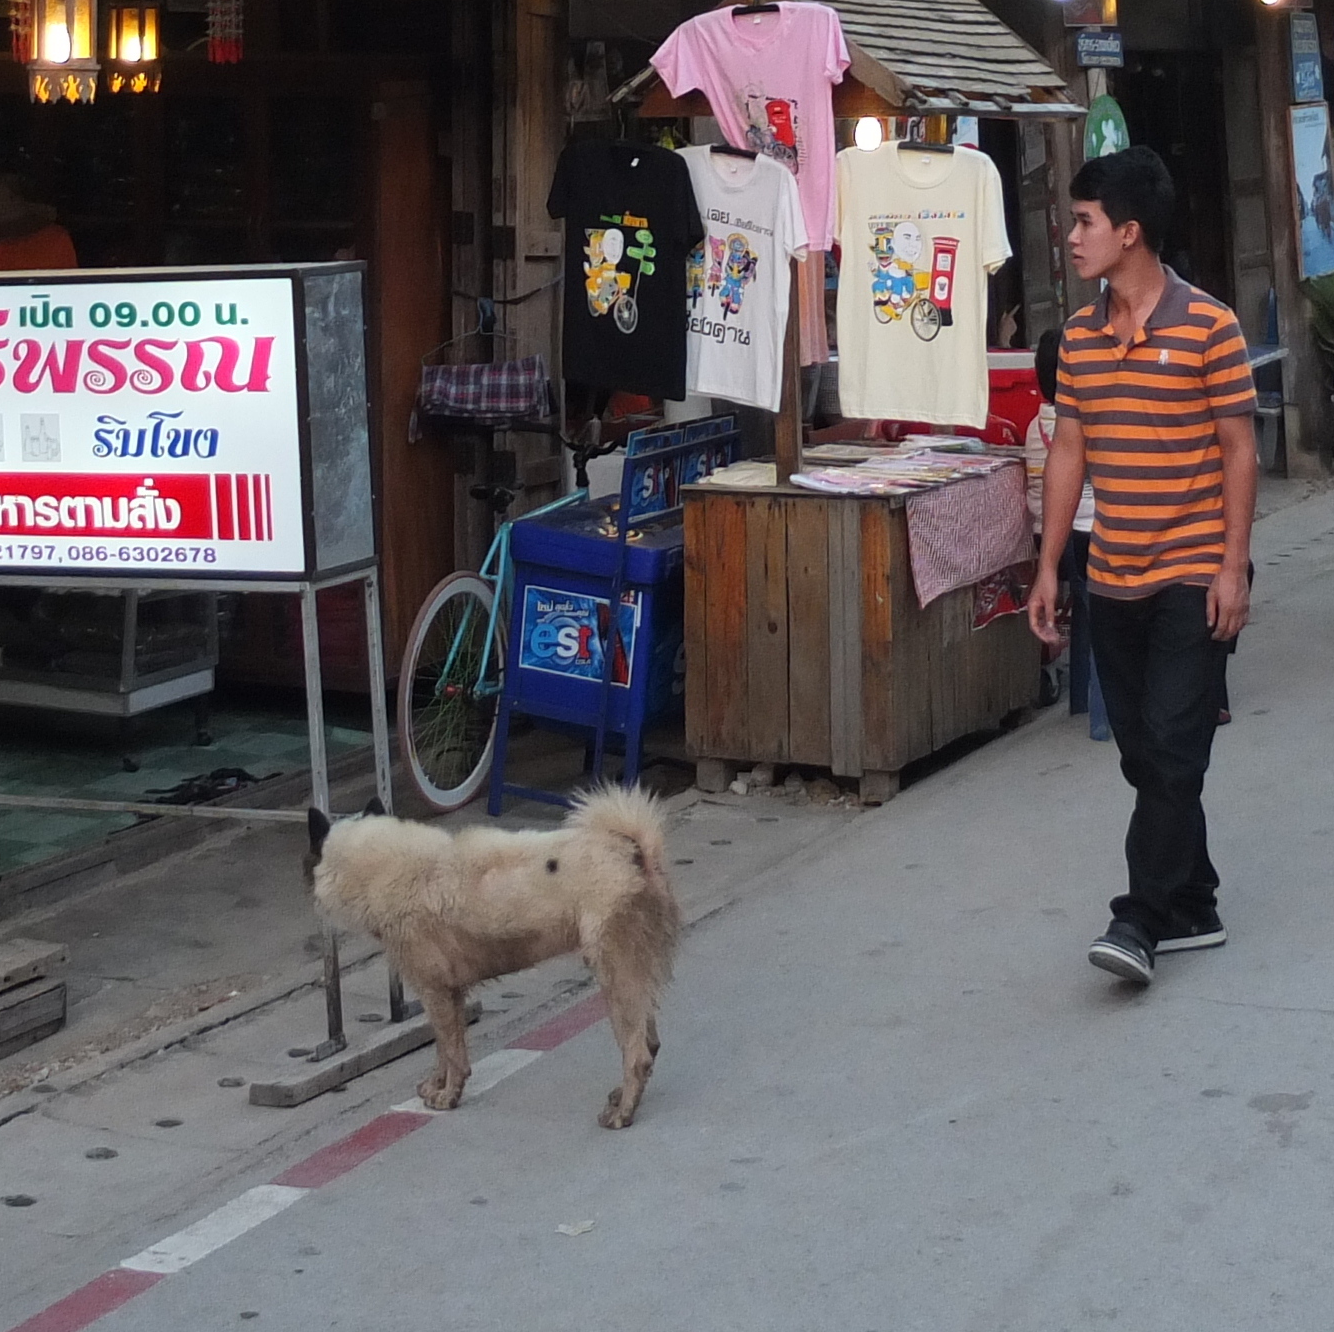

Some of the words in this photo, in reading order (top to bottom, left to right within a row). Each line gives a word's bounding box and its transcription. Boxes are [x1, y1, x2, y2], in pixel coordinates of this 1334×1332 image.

[19, 294, 74, 329] เปิด
[88, 301, 202, 328] 09.00
[215, 302, 250, 326] น.
[91, 410, 220, 459] ริมโขง
[530, 625, 593, 659] est
